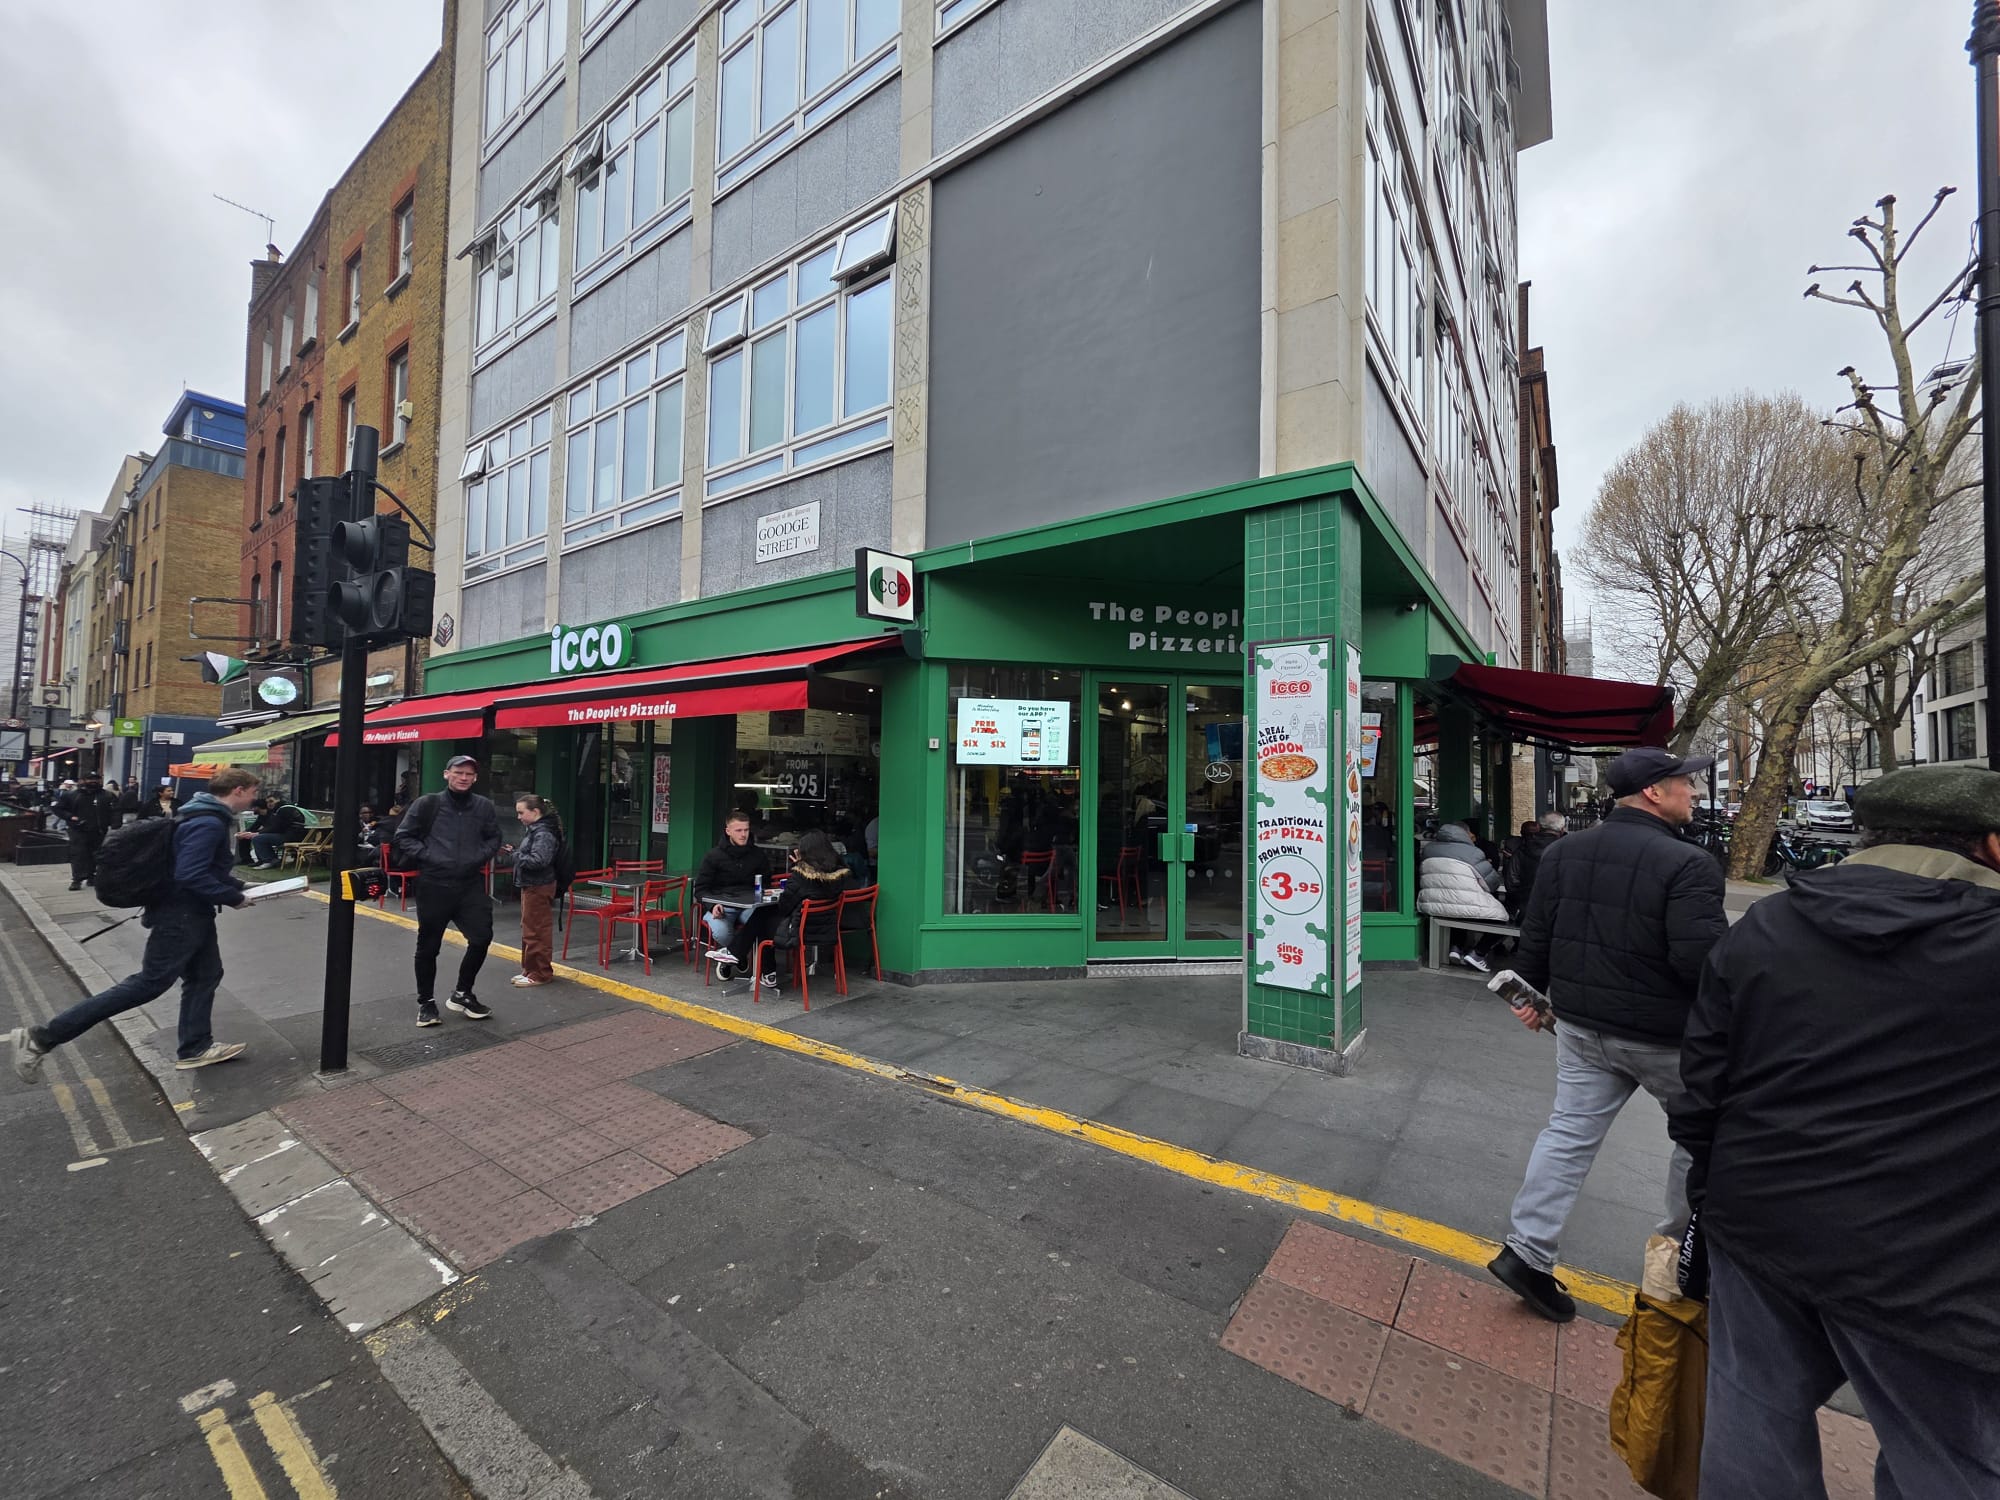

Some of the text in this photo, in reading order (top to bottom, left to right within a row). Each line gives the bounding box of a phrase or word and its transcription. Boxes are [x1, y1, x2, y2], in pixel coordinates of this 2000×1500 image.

[758, 516, 810, 540] GOODGE
[758, 536, 800, 558] STREET
[1089, 602, 1244, 630] The Peopl
[568, 701, 676, 721] The People's Pizzeria
[1265, 726, 1284, 736] REAL
[1257, 742, 1304, 760] LONDON
[786, 760, 808, 770] FROM
[776, 773, 818, 796] £3.95
[1258, 846, 1302, 864] FROM ONLY
[1262, 872, 1320, 900] £3.95
